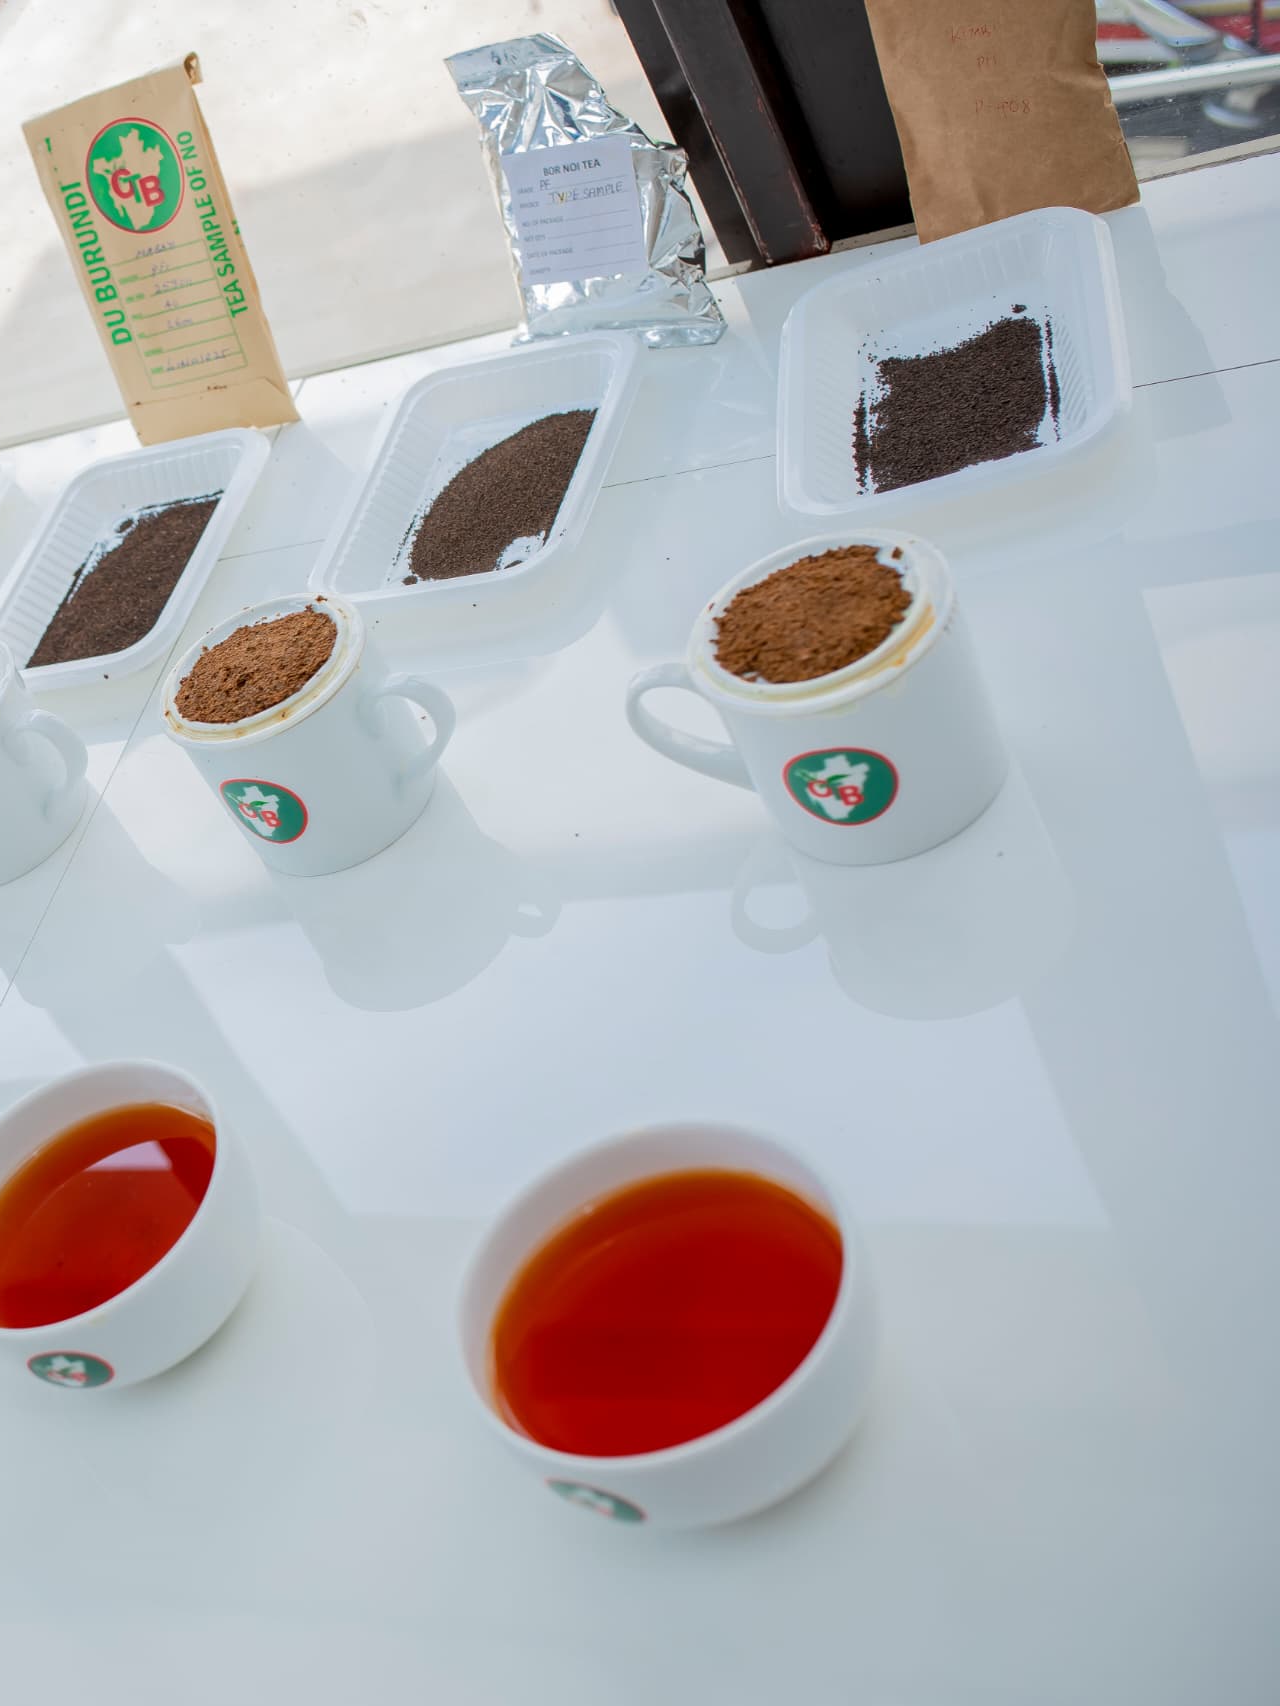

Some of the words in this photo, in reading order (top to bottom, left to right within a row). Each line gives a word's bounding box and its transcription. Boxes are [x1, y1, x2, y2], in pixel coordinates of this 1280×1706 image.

[176, 131, 198, 161] NO
[185, 166, 208, 192] OF
[543, 166, 561, 177] BOR
[563, 161, 581, 174] NOI
[582, 158, 601, 170] TEA
[583, 181, 624, 200] SAMPLE
[60, 181, 119, 303] BURUNDI
[194, 193, 235, 278] SAMPLE
[223, 278, 249, 319] TEA
[103, 309, 134, 346] DU
